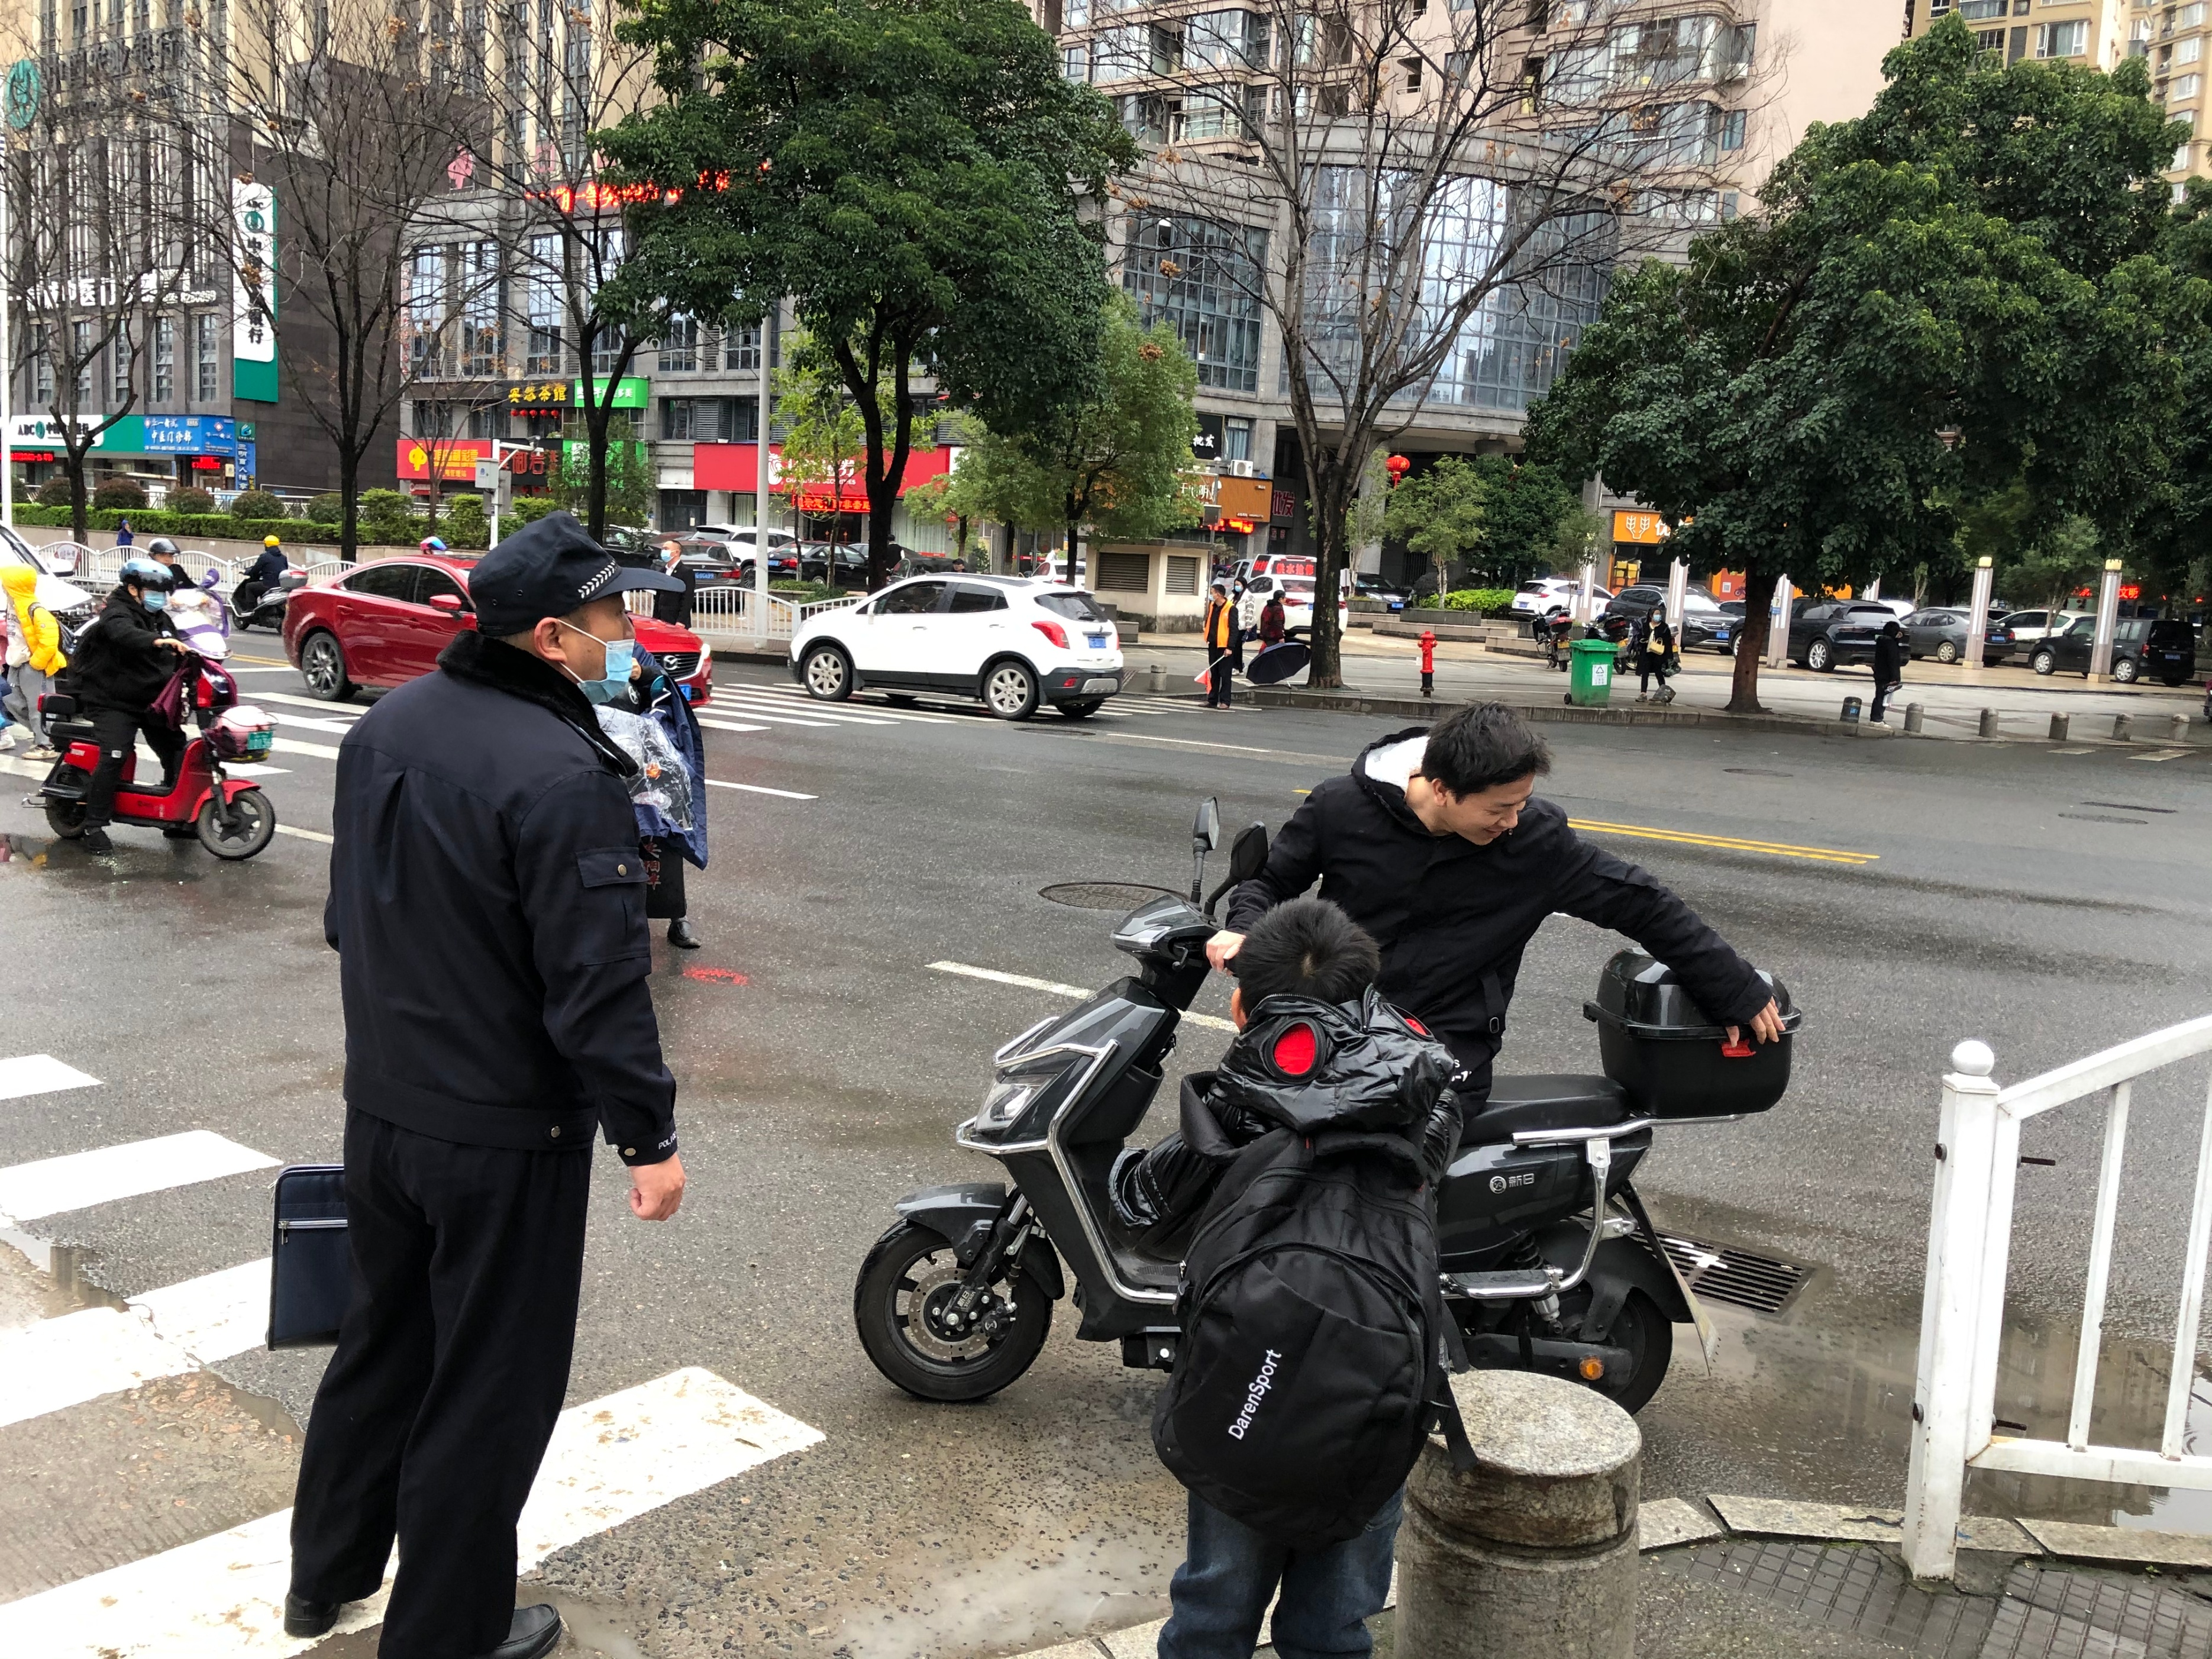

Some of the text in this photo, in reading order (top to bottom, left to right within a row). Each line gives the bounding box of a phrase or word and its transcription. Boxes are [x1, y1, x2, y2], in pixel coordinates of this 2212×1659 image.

[18, 424, 34, 435] ABC
[1508, 1173, 1535, 1187] 新日
[1228, 1349, 1282, 1440] DarenSport
